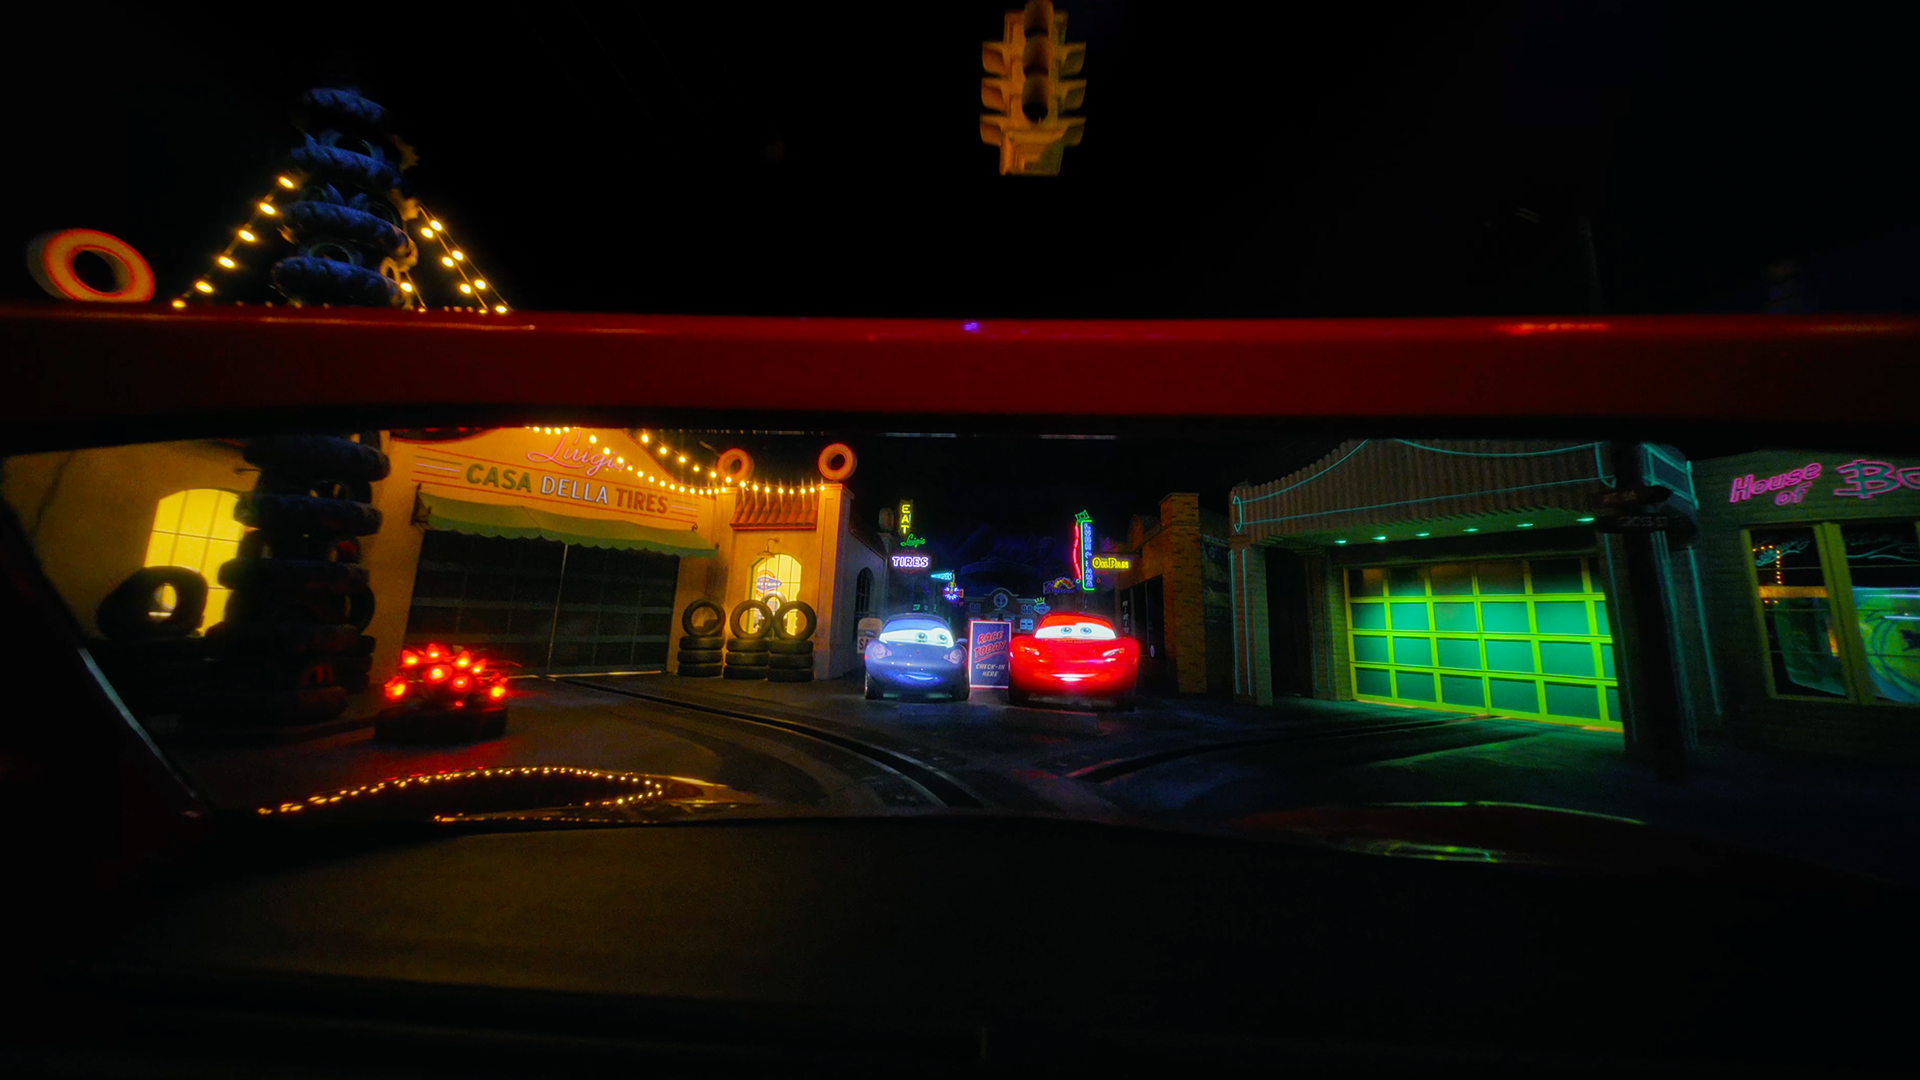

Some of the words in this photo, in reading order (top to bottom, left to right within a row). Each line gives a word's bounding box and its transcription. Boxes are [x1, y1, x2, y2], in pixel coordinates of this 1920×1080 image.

[466, 464, 532, 493] CASA
[540, 475, 609, 504] DELLA
[616, 487, 669, 514] TIRES
[1729, 462, 1823, 504] House
[1774, 481, 1812, 506] of
[901, 504, 911, 534] EAT
[892, 556, 929, 568] TIRES
[974, 640, 1008, 658] TODAY
[977, 631, 1004, 644] RACE
